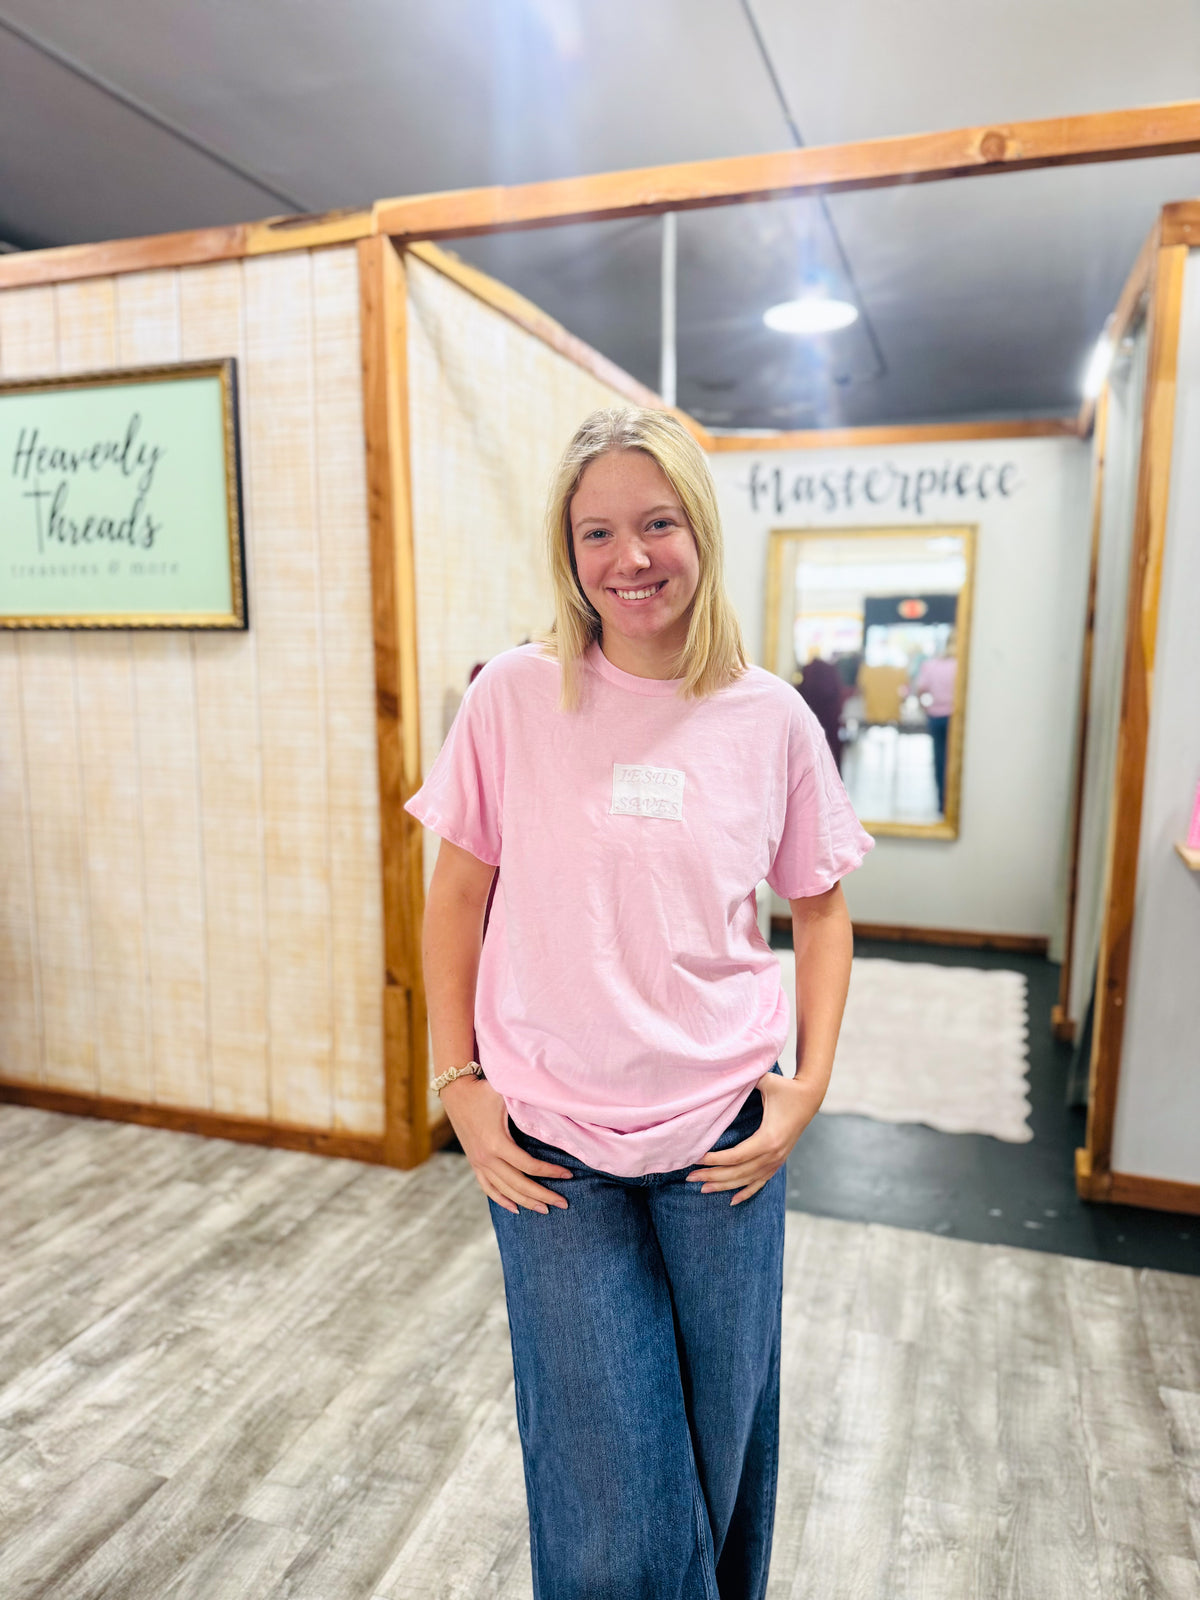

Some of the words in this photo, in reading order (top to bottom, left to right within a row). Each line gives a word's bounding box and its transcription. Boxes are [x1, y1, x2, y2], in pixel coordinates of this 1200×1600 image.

[12, 411, 164, 494] Heavenly
[23, 477, 162, 554] Threads
[738, 462, 1021, 514] Masterpiece
[615, 796, 680, 815] SAVES
